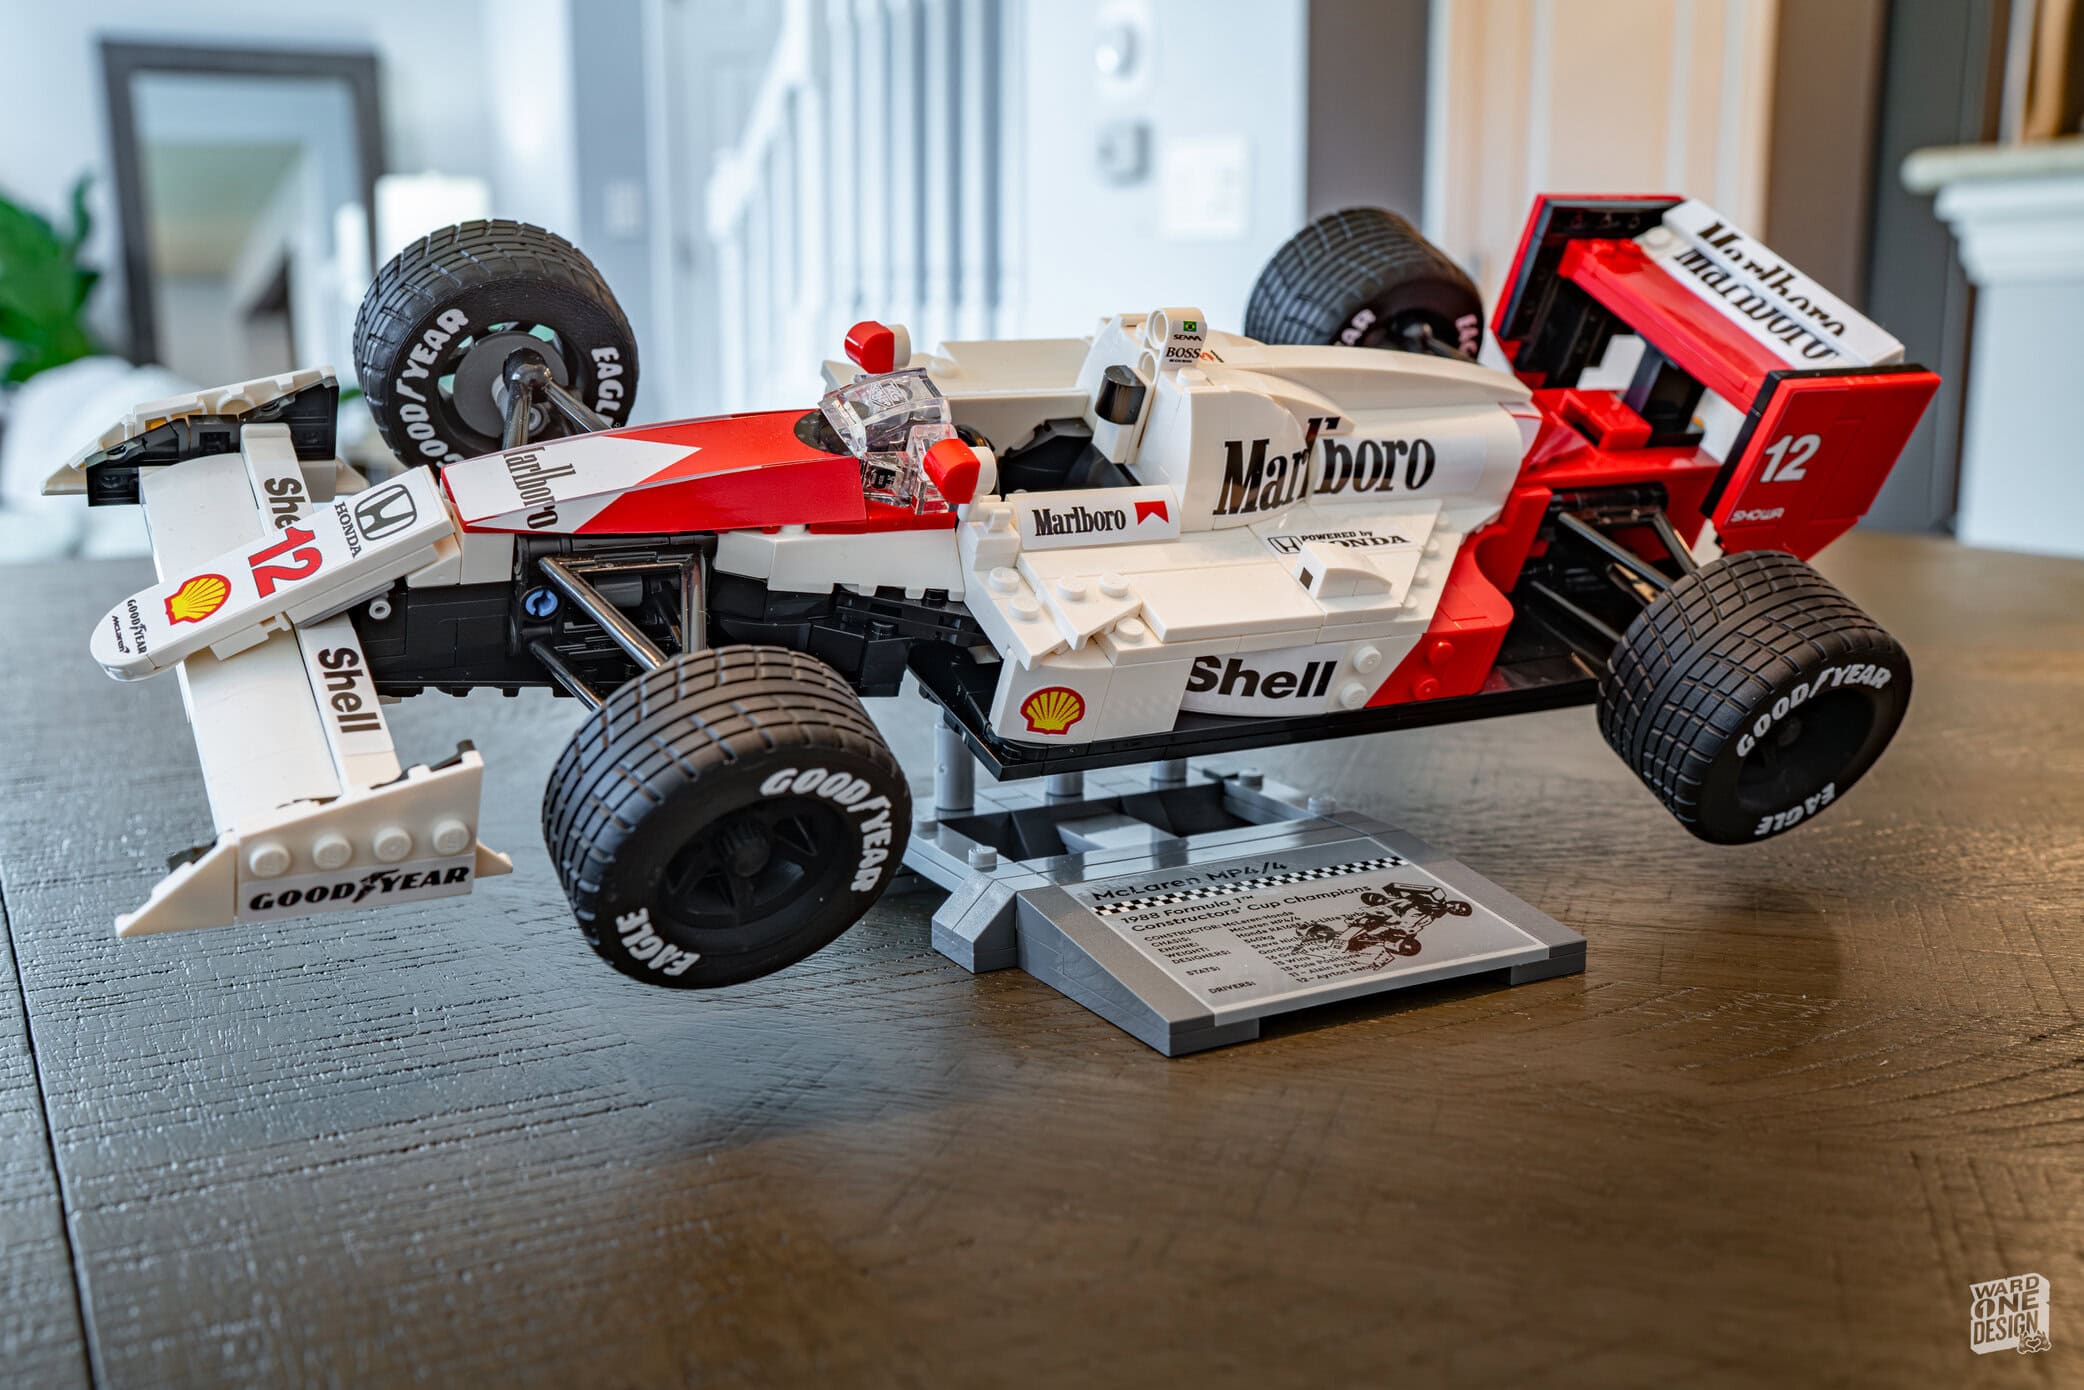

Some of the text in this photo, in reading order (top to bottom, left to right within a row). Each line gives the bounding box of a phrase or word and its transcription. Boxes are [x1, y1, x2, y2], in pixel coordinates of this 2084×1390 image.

[1166, 346, 1201, 359] BOSS
[1212, 416, 1436, 516] Marlboro
[1759, 434, 1821, 483] 12
[334, 500, 362, 559] HONDA
[1031, 505, 1127, 537] Marlboro
[1300, 530, 1374, 542] POWERED by
[247, 526, 323, 599] 12
[127, 599, 147, 654] GOODYEAR
[317, 647, 382, 733] Shell
[1185, 655, 1338, 700] Shell
[1736, 664, 1892, 758] GOODYEAR
[1754, 781, 1836, 836] EAGLE
[760, 767, 893, 893] GOODYEAR
[249, 866, 470, 911] GOODYEAR
[1092, 861, 1288, 901] McLaren MP4/4
[1247, 900, 1282, 912] Cup
[1283, 885, 1373, 906] Champions
[1121, 911, 1161, 924] 1988
[1163, 900, 1231, 917] Formula
[1229, 922, 1270, 933] McLaren
[615, 907, 701, 977] EAGLE
[1144, 924, 1222, 941] CONSTRUCTOR:
[1158, 942, 1200, 953] ENGINE:
[1164, 946, 1210, 958] WEIGHT:
[1171, 950, 1232, 965] DESIGNERS:
[1186, 966, 1221, 976] STATS:
[1208, 980, 1257, 994] DRIVERS:
